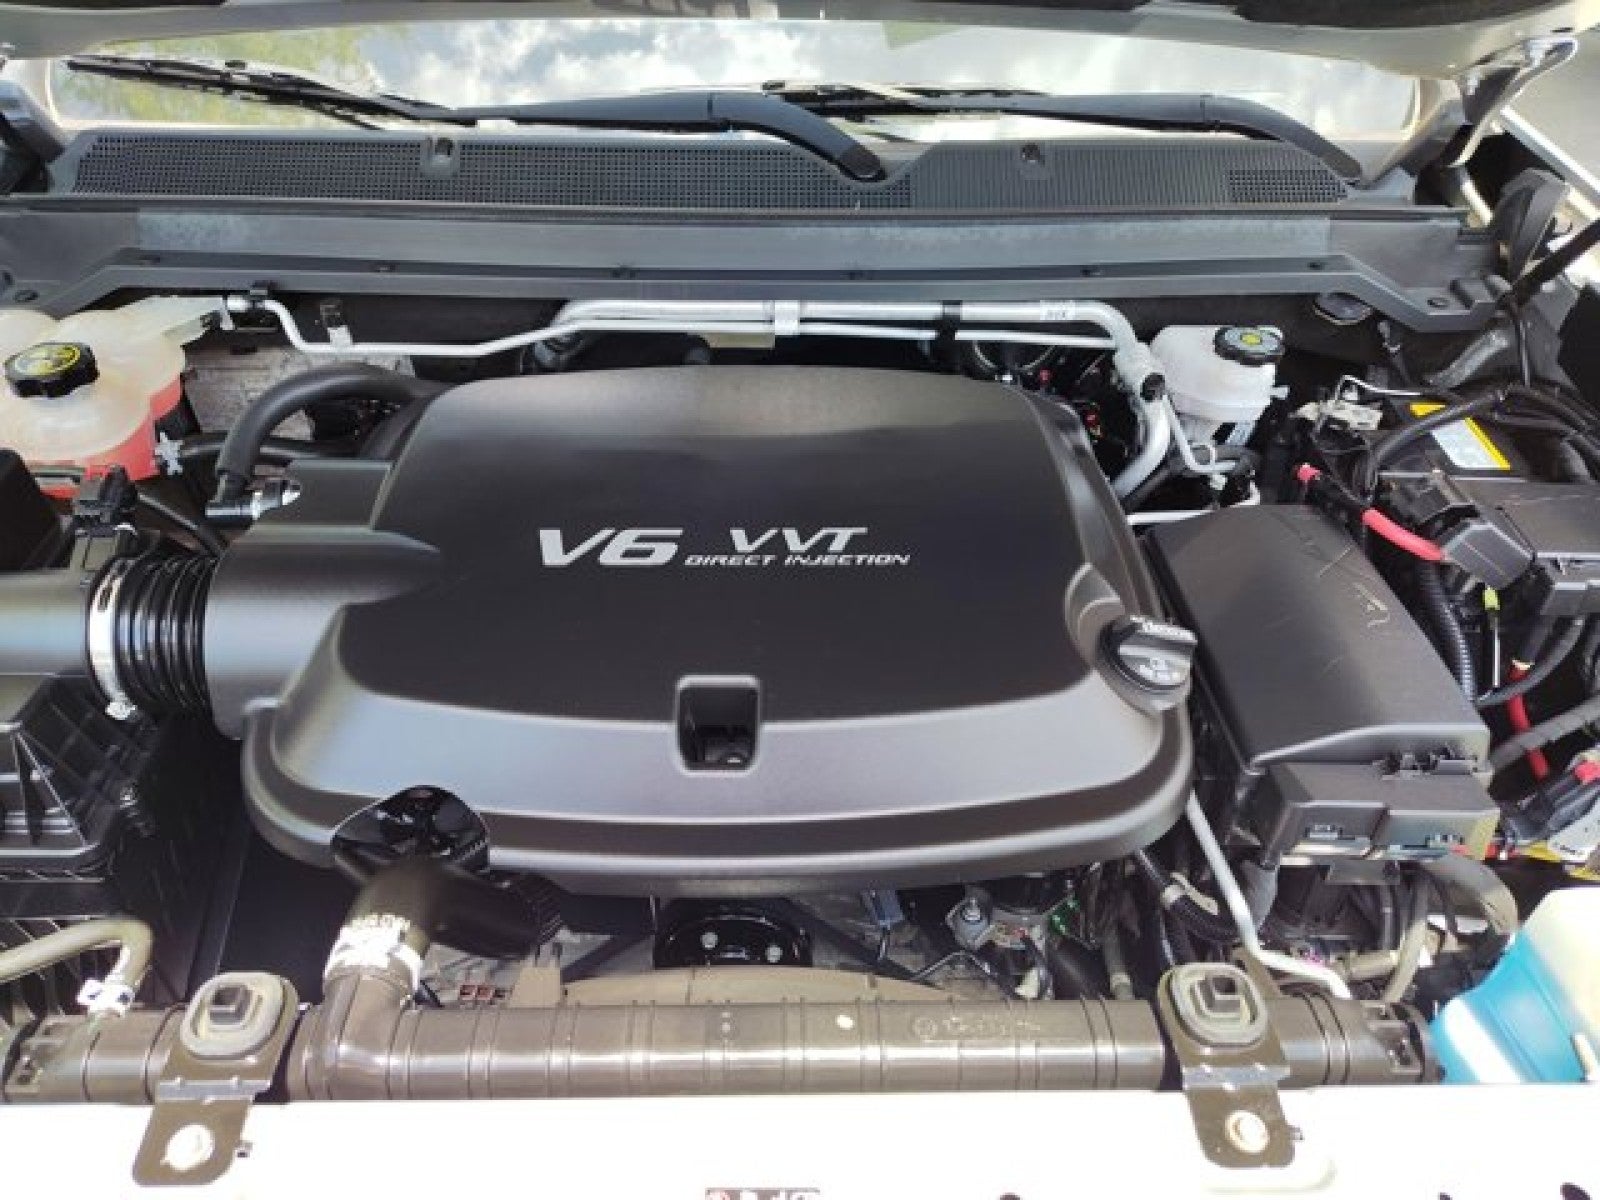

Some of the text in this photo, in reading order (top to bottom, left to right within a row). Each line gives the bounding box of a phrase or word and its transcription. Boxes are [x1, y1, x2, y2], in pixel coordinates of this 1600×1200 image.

[539, 526, 868, 566] V6 VVT
[684, 554, 911, 566] DIRECT INJECTION
